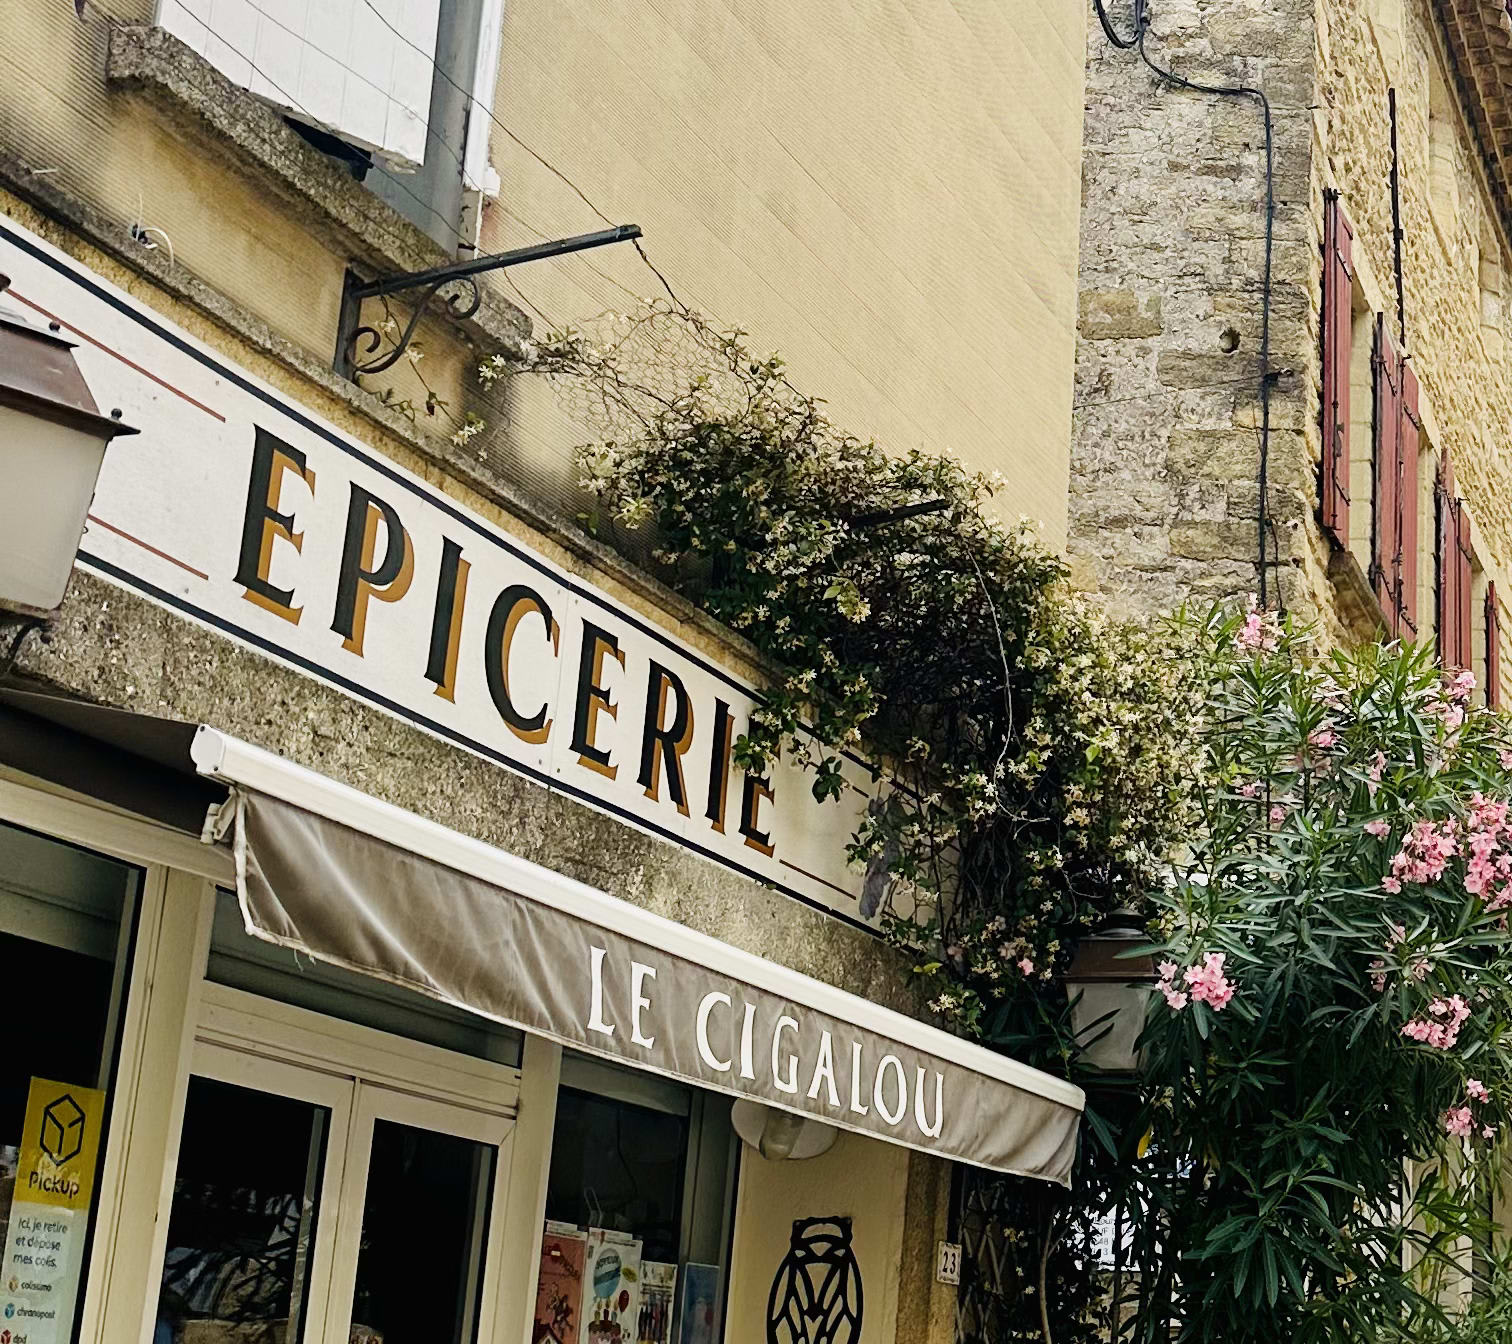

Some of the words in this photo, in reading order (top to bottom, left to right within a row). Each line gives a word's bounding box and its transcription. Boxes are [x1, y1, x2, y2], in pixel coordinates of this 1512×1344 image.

[233, 423, 777, 859] EPICERIE
[587, 945, 657, 1049] LE
[696, 991, 944, 1138] CIGALOU
[28, 1170, 80, 1199] Pickup
[15, 1236, 26, 1246] et
[13, 1253, 33, 1265] mes
[942, 1251, 956, 1274] 23
